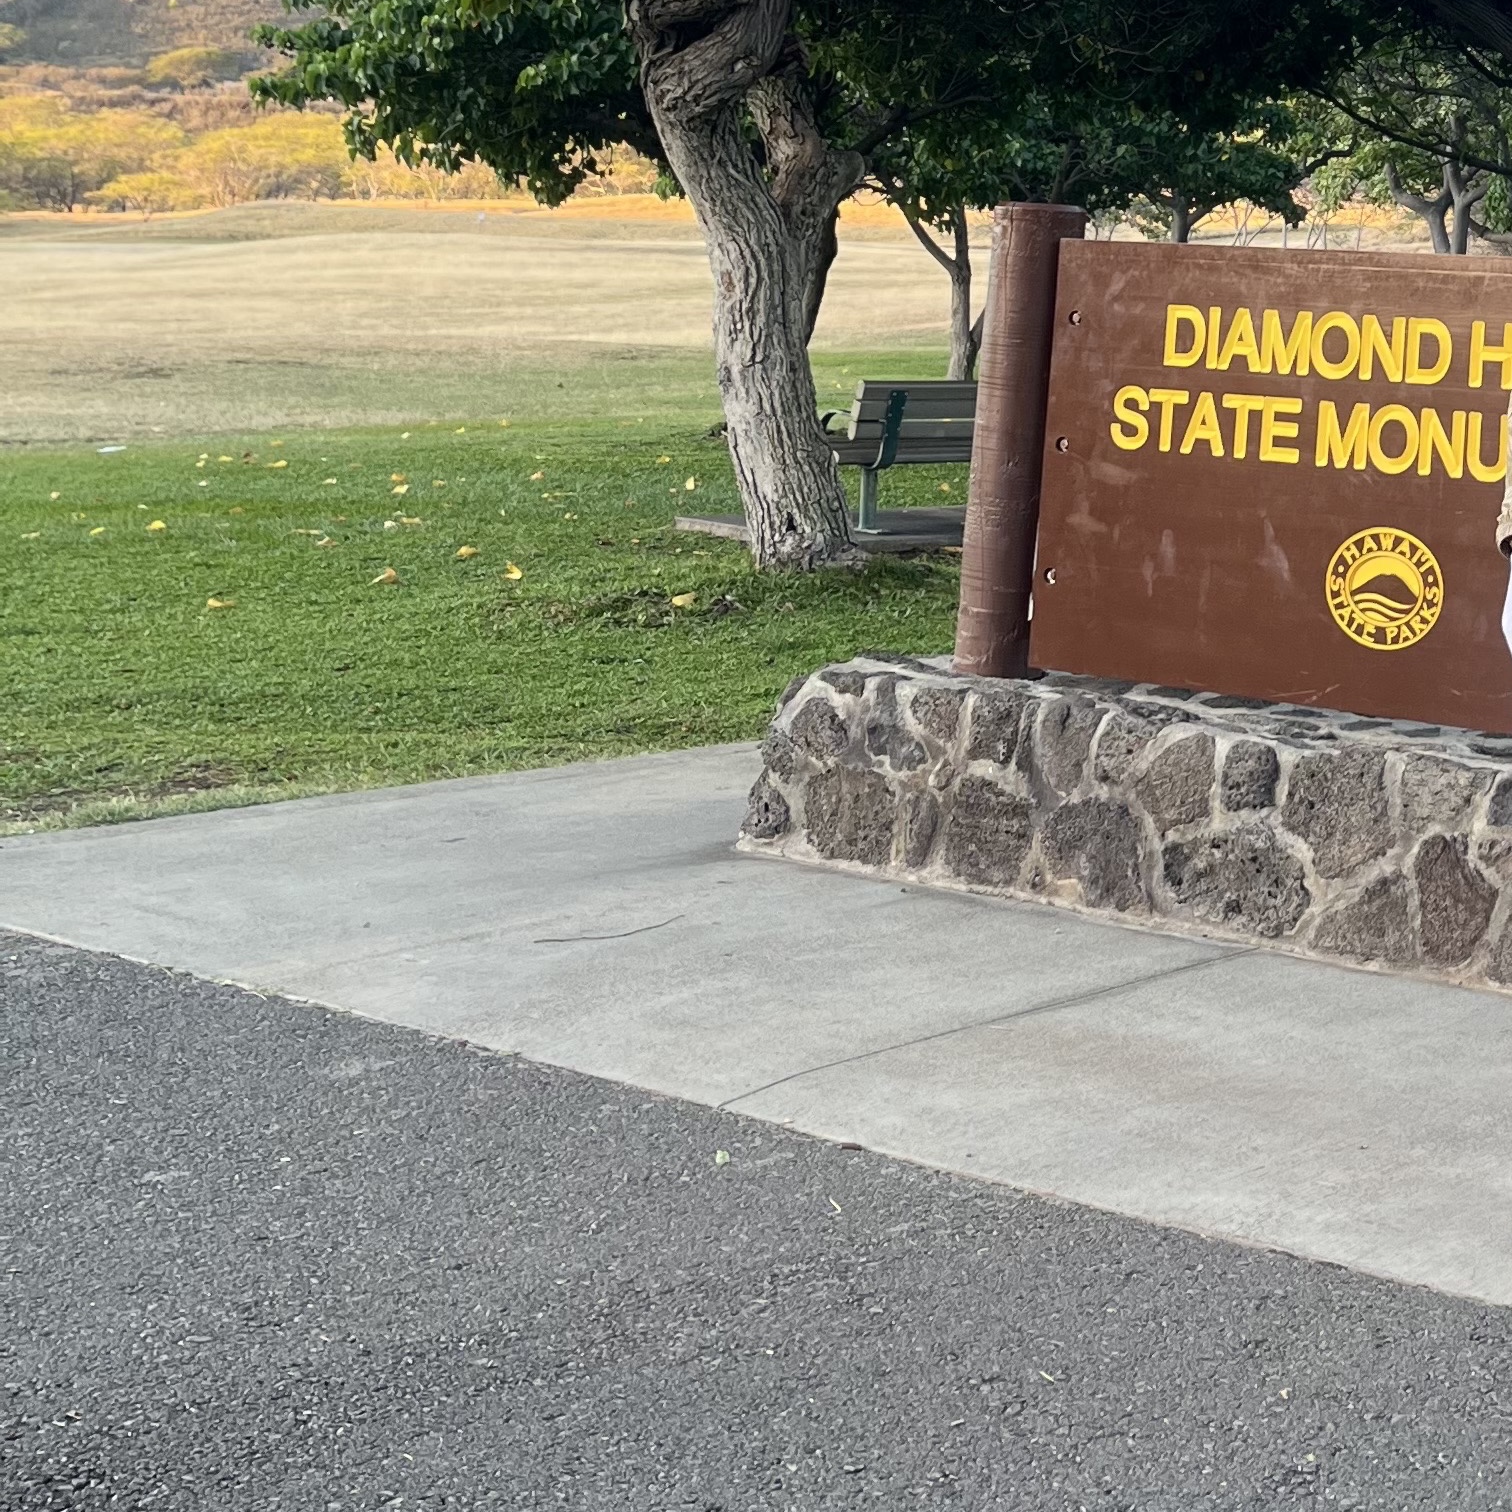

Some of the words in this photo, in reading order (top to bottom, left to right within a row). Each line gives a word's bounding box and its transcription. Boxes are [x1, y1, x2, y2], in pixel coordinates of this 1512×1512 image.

[1163, 304, 1453, 386] DIAMOND
[1110, 385, 1303, 464] STATE
[1315, 400, 1509, 483] MONU
[1330, 575, 1376, 643] STATE
[1385, 586, 1439, 645] PARKS
